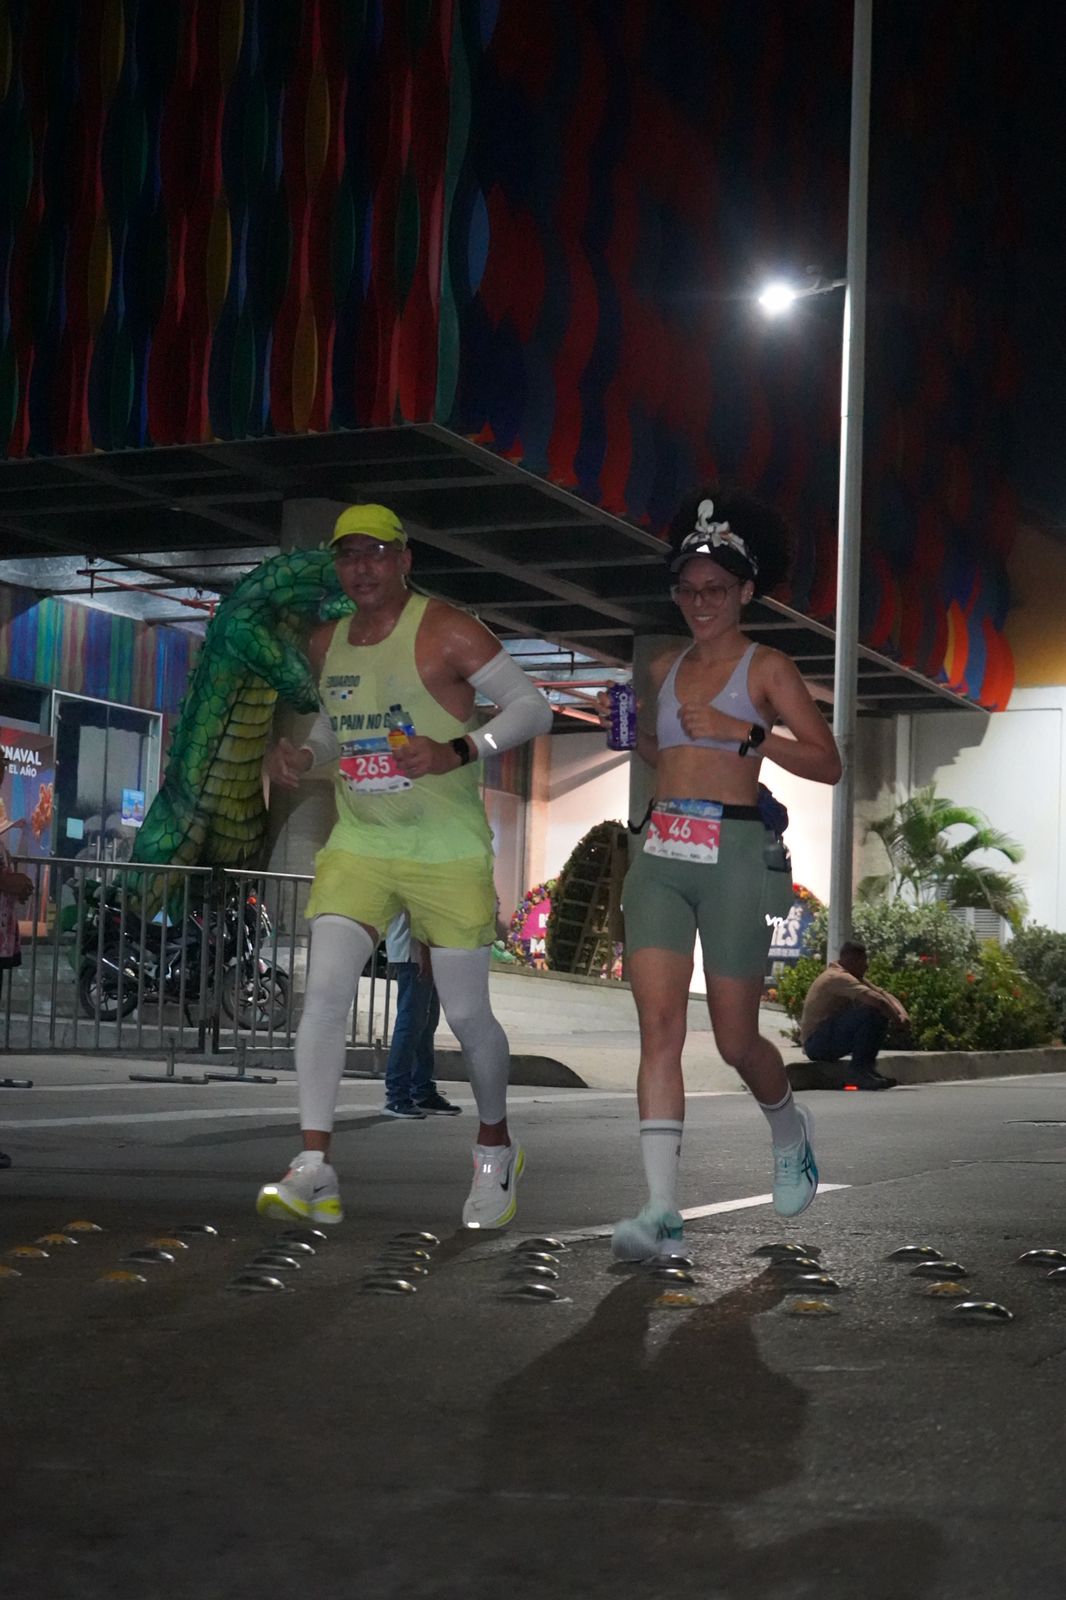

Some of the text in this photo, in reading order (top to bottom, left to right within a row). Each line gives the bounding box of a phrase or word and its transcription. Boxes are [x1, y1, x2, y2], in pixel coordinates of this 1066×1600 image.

[340, 714, 365, 731] PAIN
[366, 713, 382, 729] NO
[1, 745, 42, 766] NAVAL
[8, 764, 37, 778] EL AÑO
[355, 756, 391, 776] 265
[668, 817, 692, 839] 46
